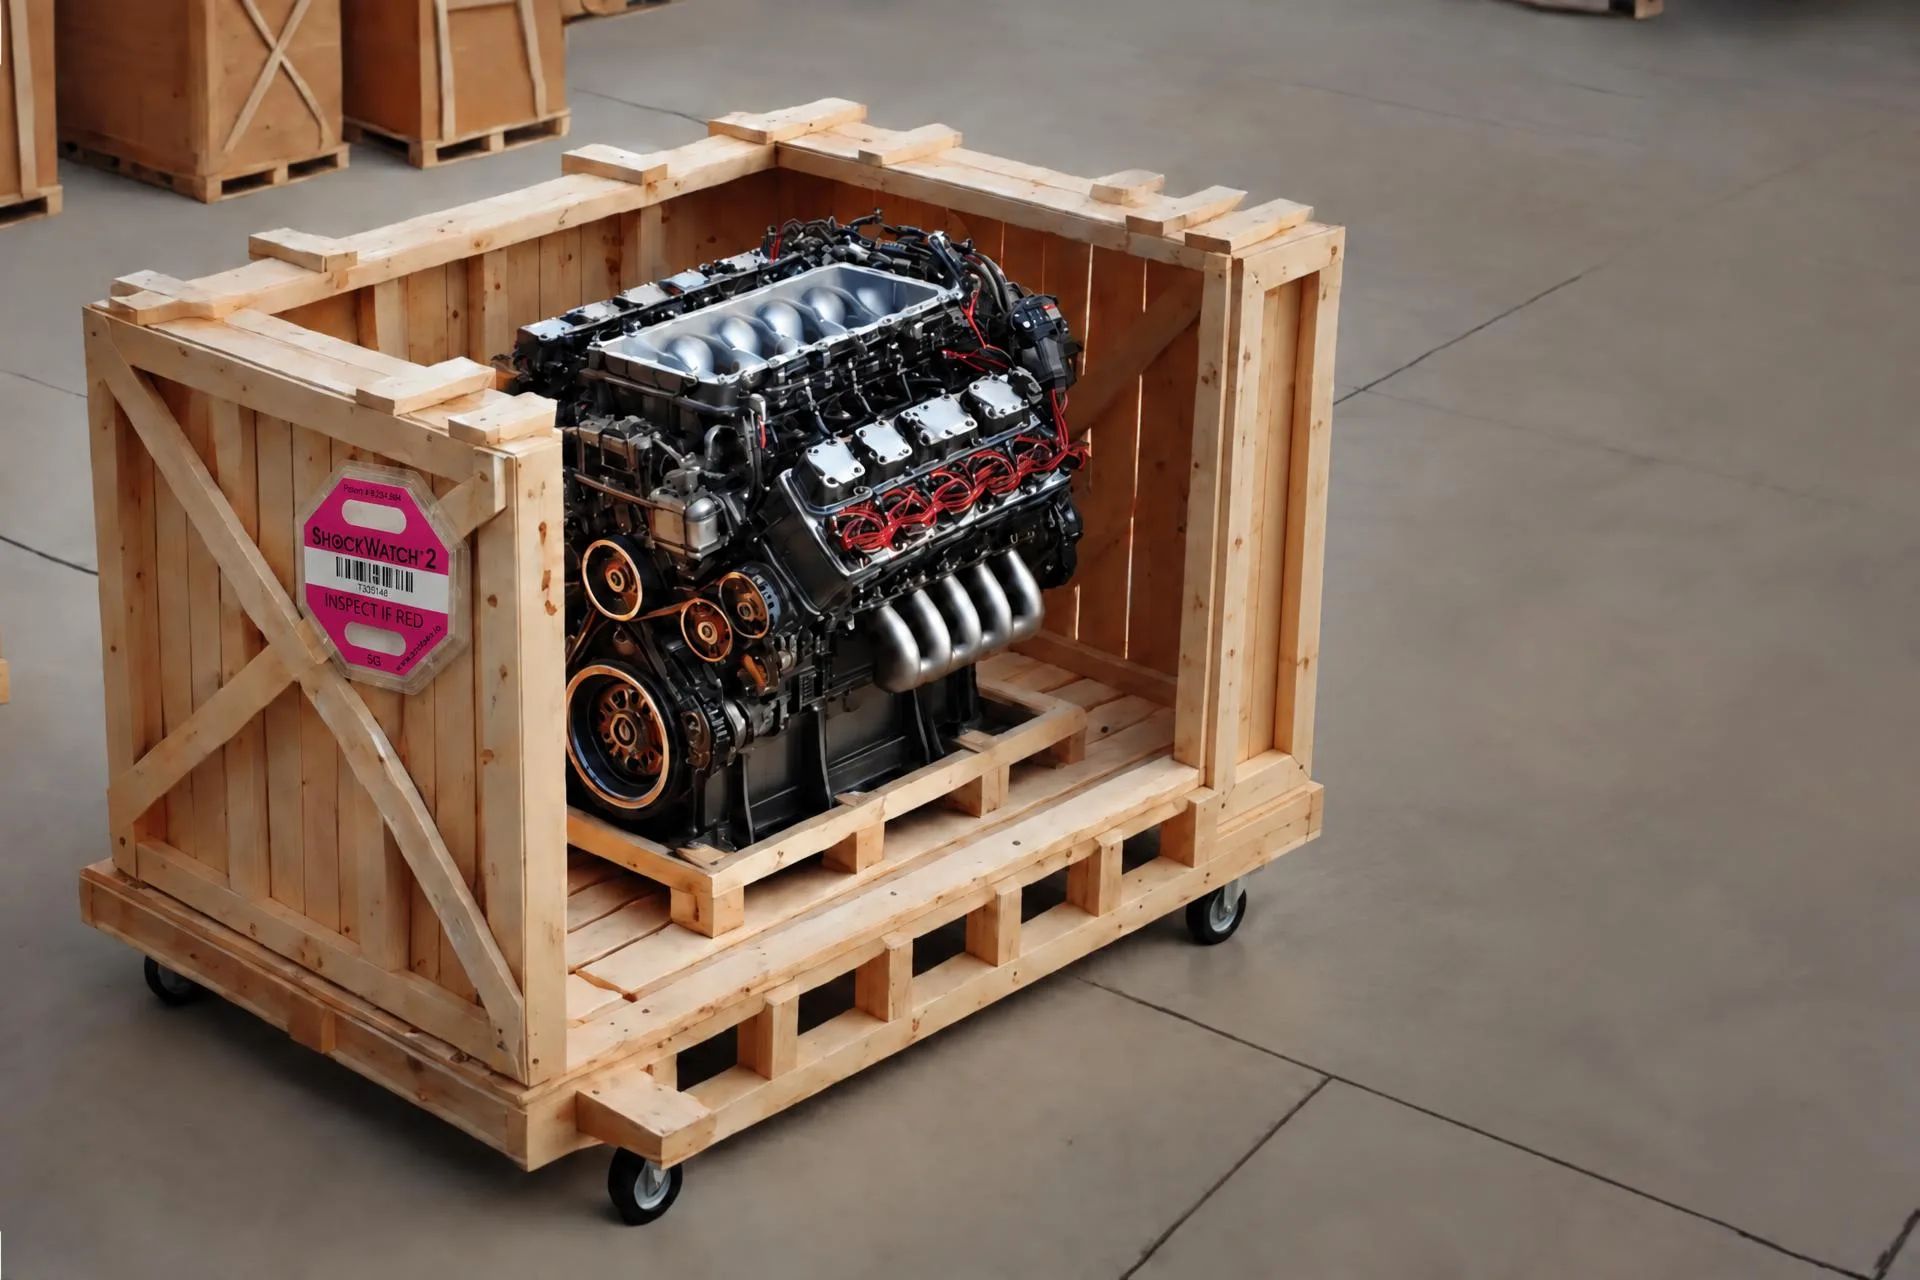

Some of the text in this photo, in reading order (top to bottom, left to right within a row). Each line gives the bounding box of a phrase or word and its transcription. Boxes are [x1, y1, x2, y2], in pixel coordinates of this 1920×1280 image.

[425, 547, 437, 569] 2
[324, 592, 424, 629] INSPECT IF RED
